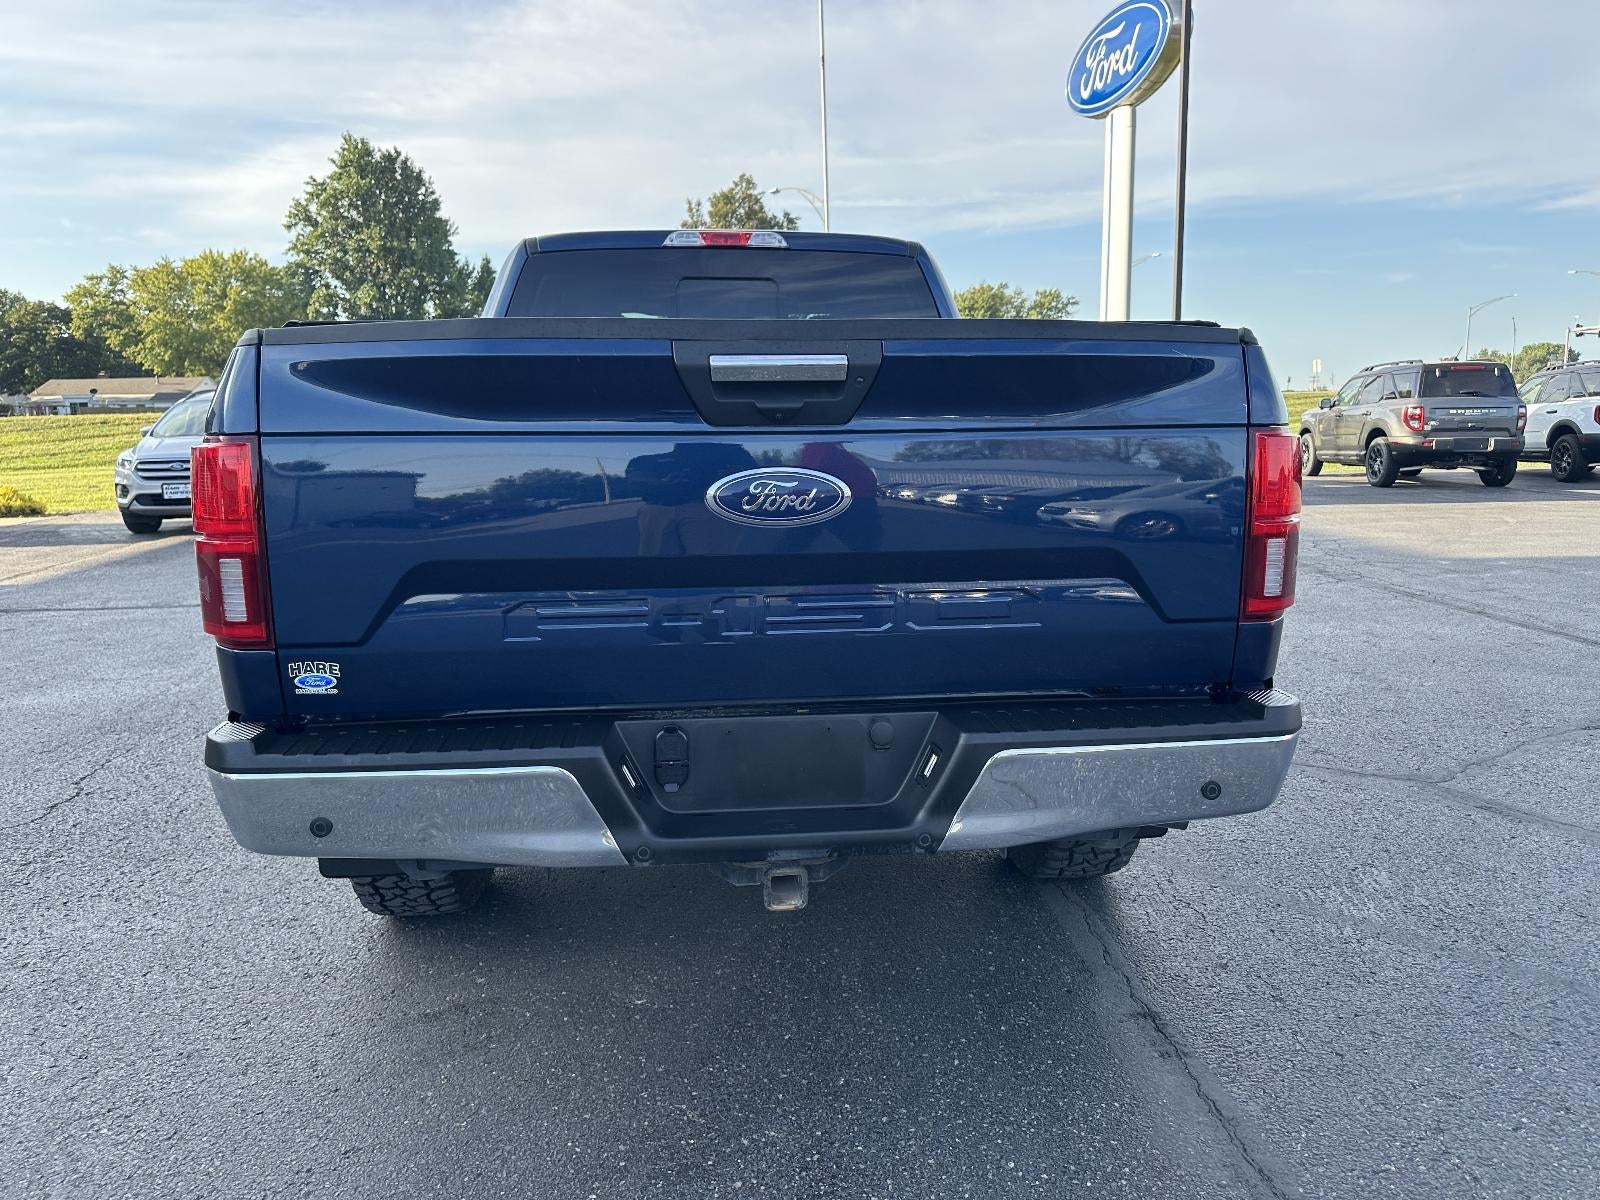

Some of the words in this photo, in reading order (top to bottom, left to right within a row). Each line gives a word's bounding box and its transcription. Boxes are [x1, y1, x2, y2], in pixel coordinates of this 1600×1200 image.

[1080, 20, 1142, 100] Ford
[741, 479, 818, 512] Ford
[288, 661, 341, 677] HARE
[304, 677, 327, 686] Ford
